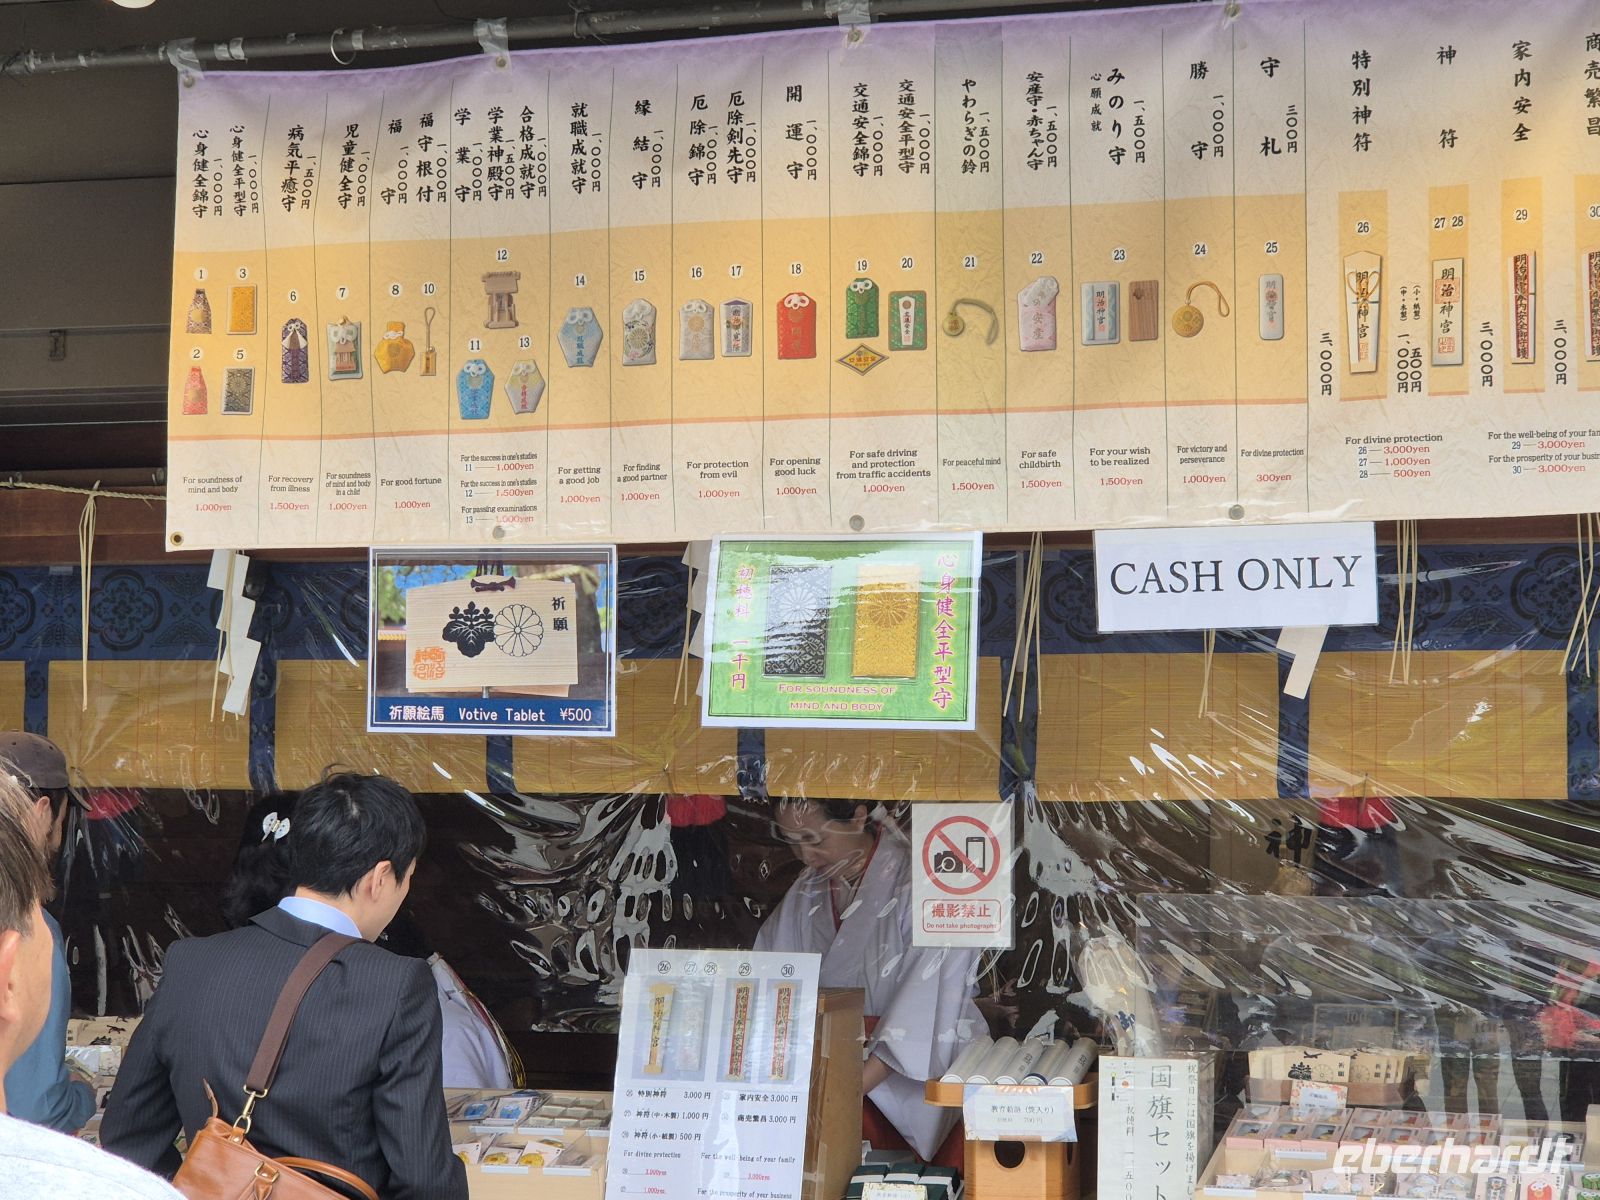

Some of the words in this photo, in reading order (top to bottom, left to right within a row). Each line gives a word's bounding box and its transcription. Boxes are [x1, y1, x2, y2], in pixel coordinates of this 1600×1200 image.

[1511, 40, 1532, 142] 家内安全
[1090, 72, 1102, 132] 心願成就
[1351, 49, 1373, 152] 特別神符
[1107, 68, 1126, 165] みのり守
[785, 84, 804, 179] 開運守
[852, 82, 870, 177] 交通安全錦守
[897, 79, 916, 174] 交通安全平型守
[961, 78, 977, 174] やわらぎの鈴
[687, 95, 708, 186] 厄除錦守
[726, 91, 745, 184] 厄除剣先守
[569, 102, 588, 194] 就職成就守
[631, 99, 652, 190] 縁結守
[454, 108, 472, 202] 学業守
[487, 106, 504, 201] 学業神殿守
[519, 105, 536, 199] 合格成就守
[230, 125, 247, 217] 心身健全平型守
[281, 124, 304, 212] 病気平癒守
[338, 123, 360, 209] 児童健全守
[192, 129, 209, 218] 心身健全錦守
[1516, 209, 1528, 221] 29
[1357, 222, 1370, 233] 26
[1434, 217, 1446, 228] 27
[1452, 216, 1464, 227] 28
[1194, 244, 1207, 255] 24
[1266, 242, 1278, 253] 25
[497, 250, 507, 260] 12
[1031, 253, 1043, 264] 22
[1114, 250, 1125, 260] 23
[857, 260, 868, 271] 19
[902, 258, 912, 268] 20
[964, 256, 976, 268] 21
[199, 270, 204, 279] 1
[239, 268, 246, 278] 3
[692, 268, 702, 278] 16
[731, 266, 742, 276] 17
[791, 264, 802, 274] 18
[575, 276, 585, 286] 14
[634, 270, 644, 282] 15
[339, 288, 346, 298] 7
[392, 284, 400, 296] 8
[424, 284, 434, 294] 10
[290, 290, 296, 302] 6
[1440, 267, 1455, 334] 明治神宮
[470, 340, 480, 350] 11
[520, 338, 530, 348] 13
[193, 348, 200, 359] 2
[236, 349, 244, 360] 5
[1345, 436, 1362, 446] For
[1363, 435, 1392, 444] divine
[1394, 434, 1443, 444] protection
[850, 450, 865, 458] For
[866, 450, 886, 458] safe
[887, 448, 918, 458] driving
[1021, 450, 1036, 458] For
[1038, 450, 1057, 458] safe
[1090, 448, 1105, 456] For
[1106, 448, 1128, 457] your
[1129, 446, 1151, 456] wish
[1358, 446, 1368, 454] 26
[686, 462, 702, 470] For
[703, 460, 749, 470] protection
[769, 458, 784, 466] For
[786, 457, 822, 466] opening
[870, 460, 915, 468] protection
[1019, 460, 1061, 469] childbirth
[1090, 458, 1099, 466] to
[1100, 458, 1111, 466] be
[1113, 457, 1150, 466] realized
[1358, 458, 1368, 466] 27
[574, 466, 601, 474] getting
[700, 471, 720, 479] from
[774, 468, 796, 477] good
[797, 467, 816, 475] luck
[836, 472, 857, 480] from
[858, 470, 886, 479] traffic
[887, 470, 931, 478] accidents
[1360, 470, 1368, 479] 28
[1393, 469, 1431, 479] 500yen
[183, 476, 195, 484] For
[198, 476, 234, 484] soundness
[234, 475, 242, 483] of
[380, 478, 394, 486] For
[396, 478, 413, 486] good
[414, 477, 442, 485] fortune
[566, 477, 586, 485] good
[587, 476, 600, 485] job
[188, 486, 206, 494] mind
[208, 486, 220, 494] and
[222, 486, 238, 494] body
[1110, 560, 1224, 595] CASH
[1237, 555, 1362, 592] ONLY
[552, 596, 569, 632] 祈願
[932, 555, 957, 709] 心身健全平型守
[779, 684, 803, 694] FOR
[805, 685, 877, 695] SOUNDNESS
[879, 686, 896, 695] OF
[789, 702, 821, 711] MIND
[823, 702, 848, 711] AND
[850, 702, 884, 712] BODY
[388, 704, 445, 722] 祈願絵馬
[458, 707, 498, 721] Votive
[505, 708, 545, 721] Tablet
[559, 707, 592, 722] ¥500
[931, 903, 992, 919] 撮影禁止
[1147, 1065, 1175, 1200] 国旗セット
